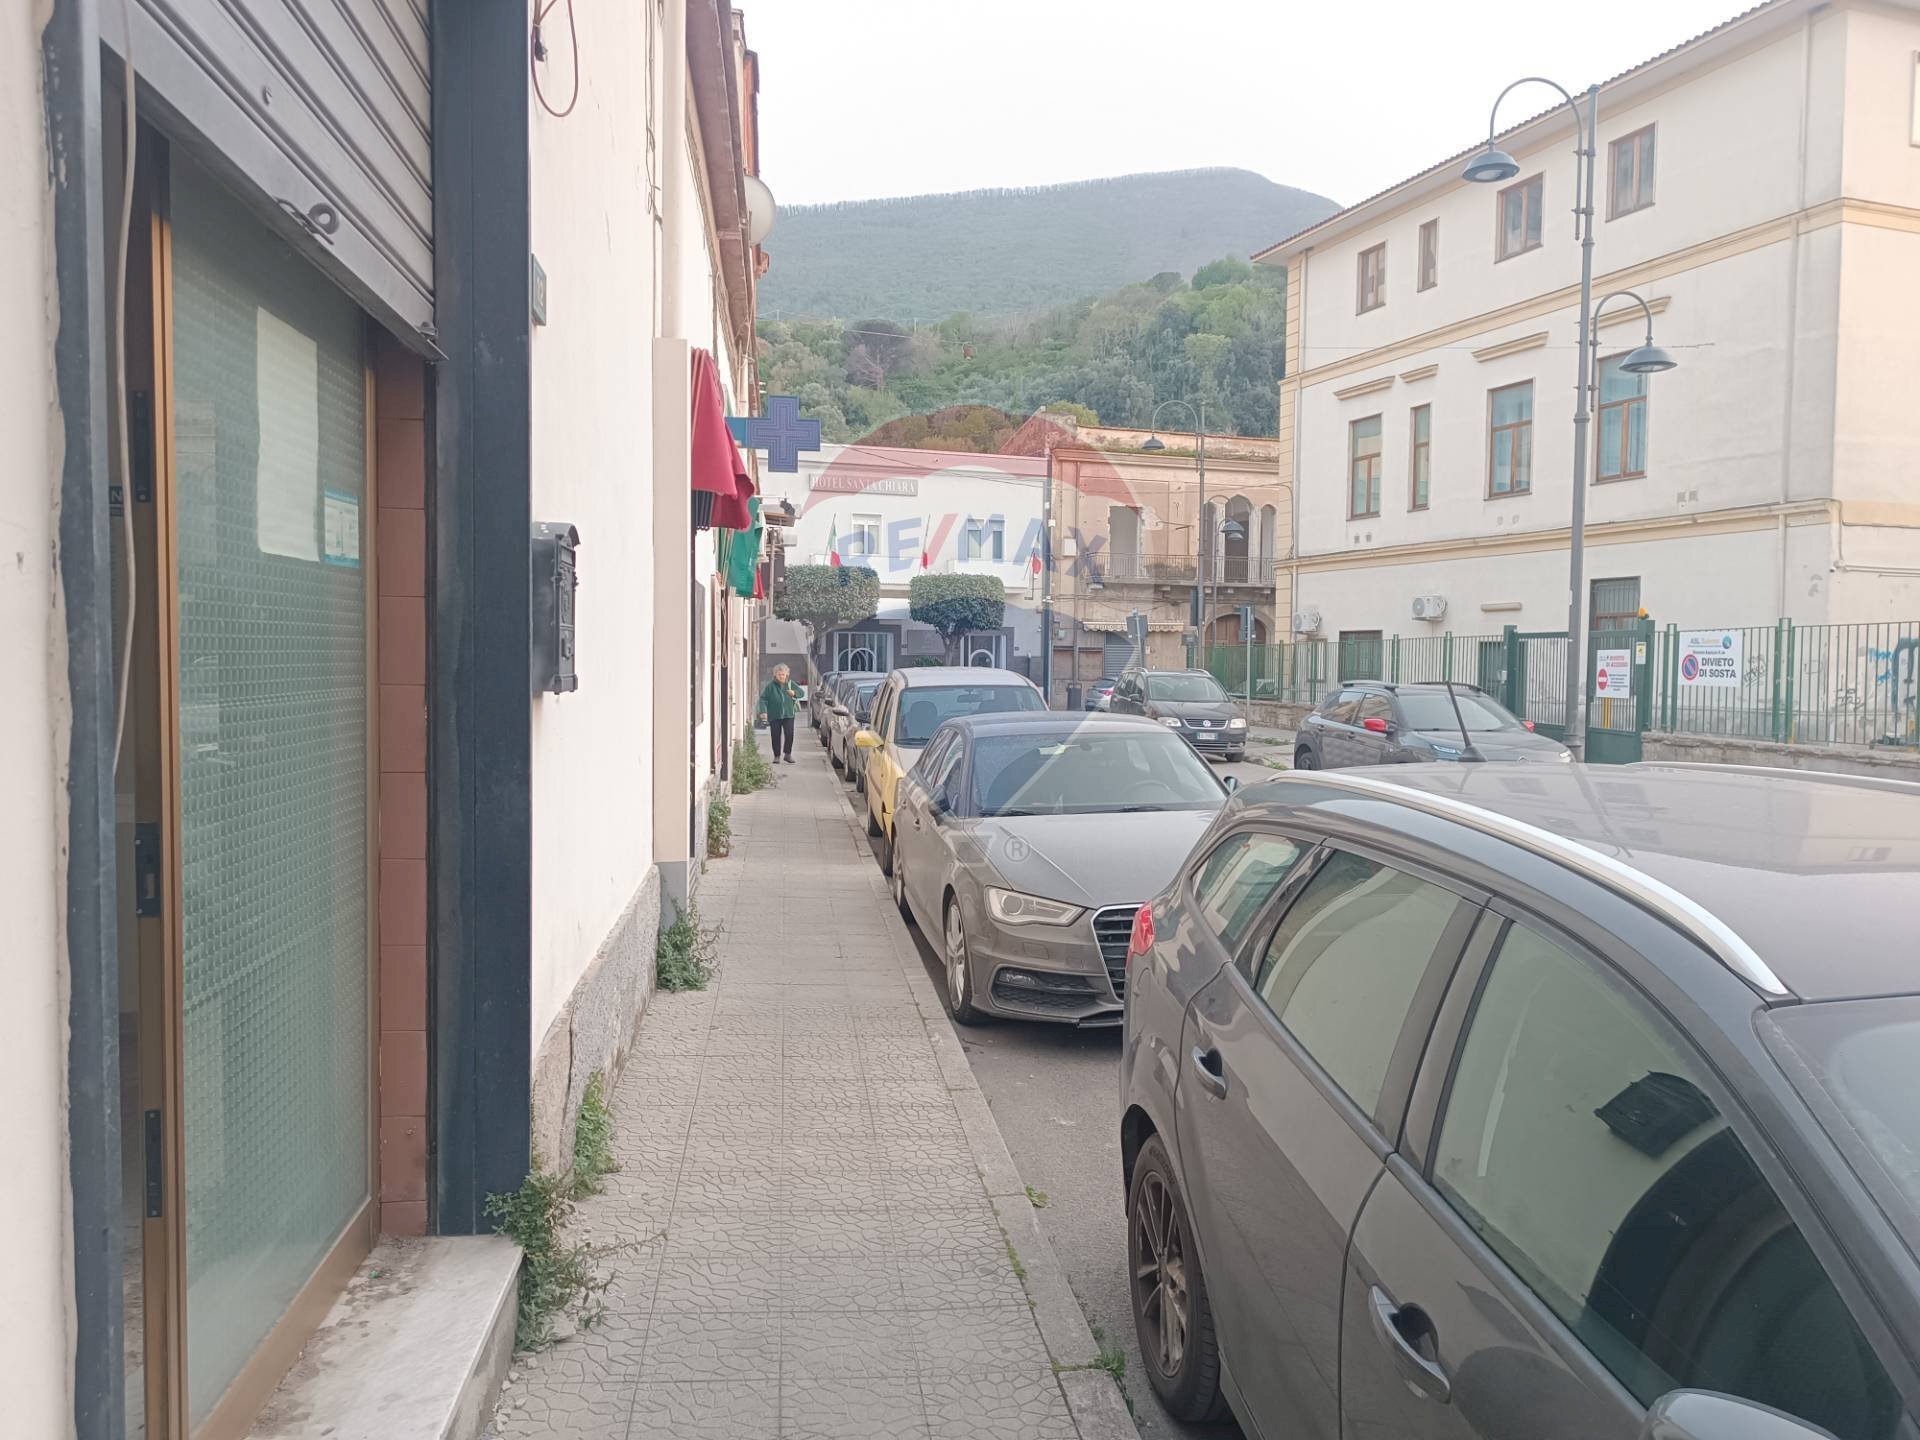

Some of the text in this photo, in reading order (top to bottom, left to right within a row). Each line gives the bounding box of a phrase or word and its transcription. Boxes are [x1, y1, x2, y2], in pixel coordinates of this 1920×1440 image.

[811, 473, 916, 493] HOTEL SANTA CHIARA
[1701, 657, 1734, 666] DIVIETO
[1699, 668, 1736, 678] DI SOSTA
